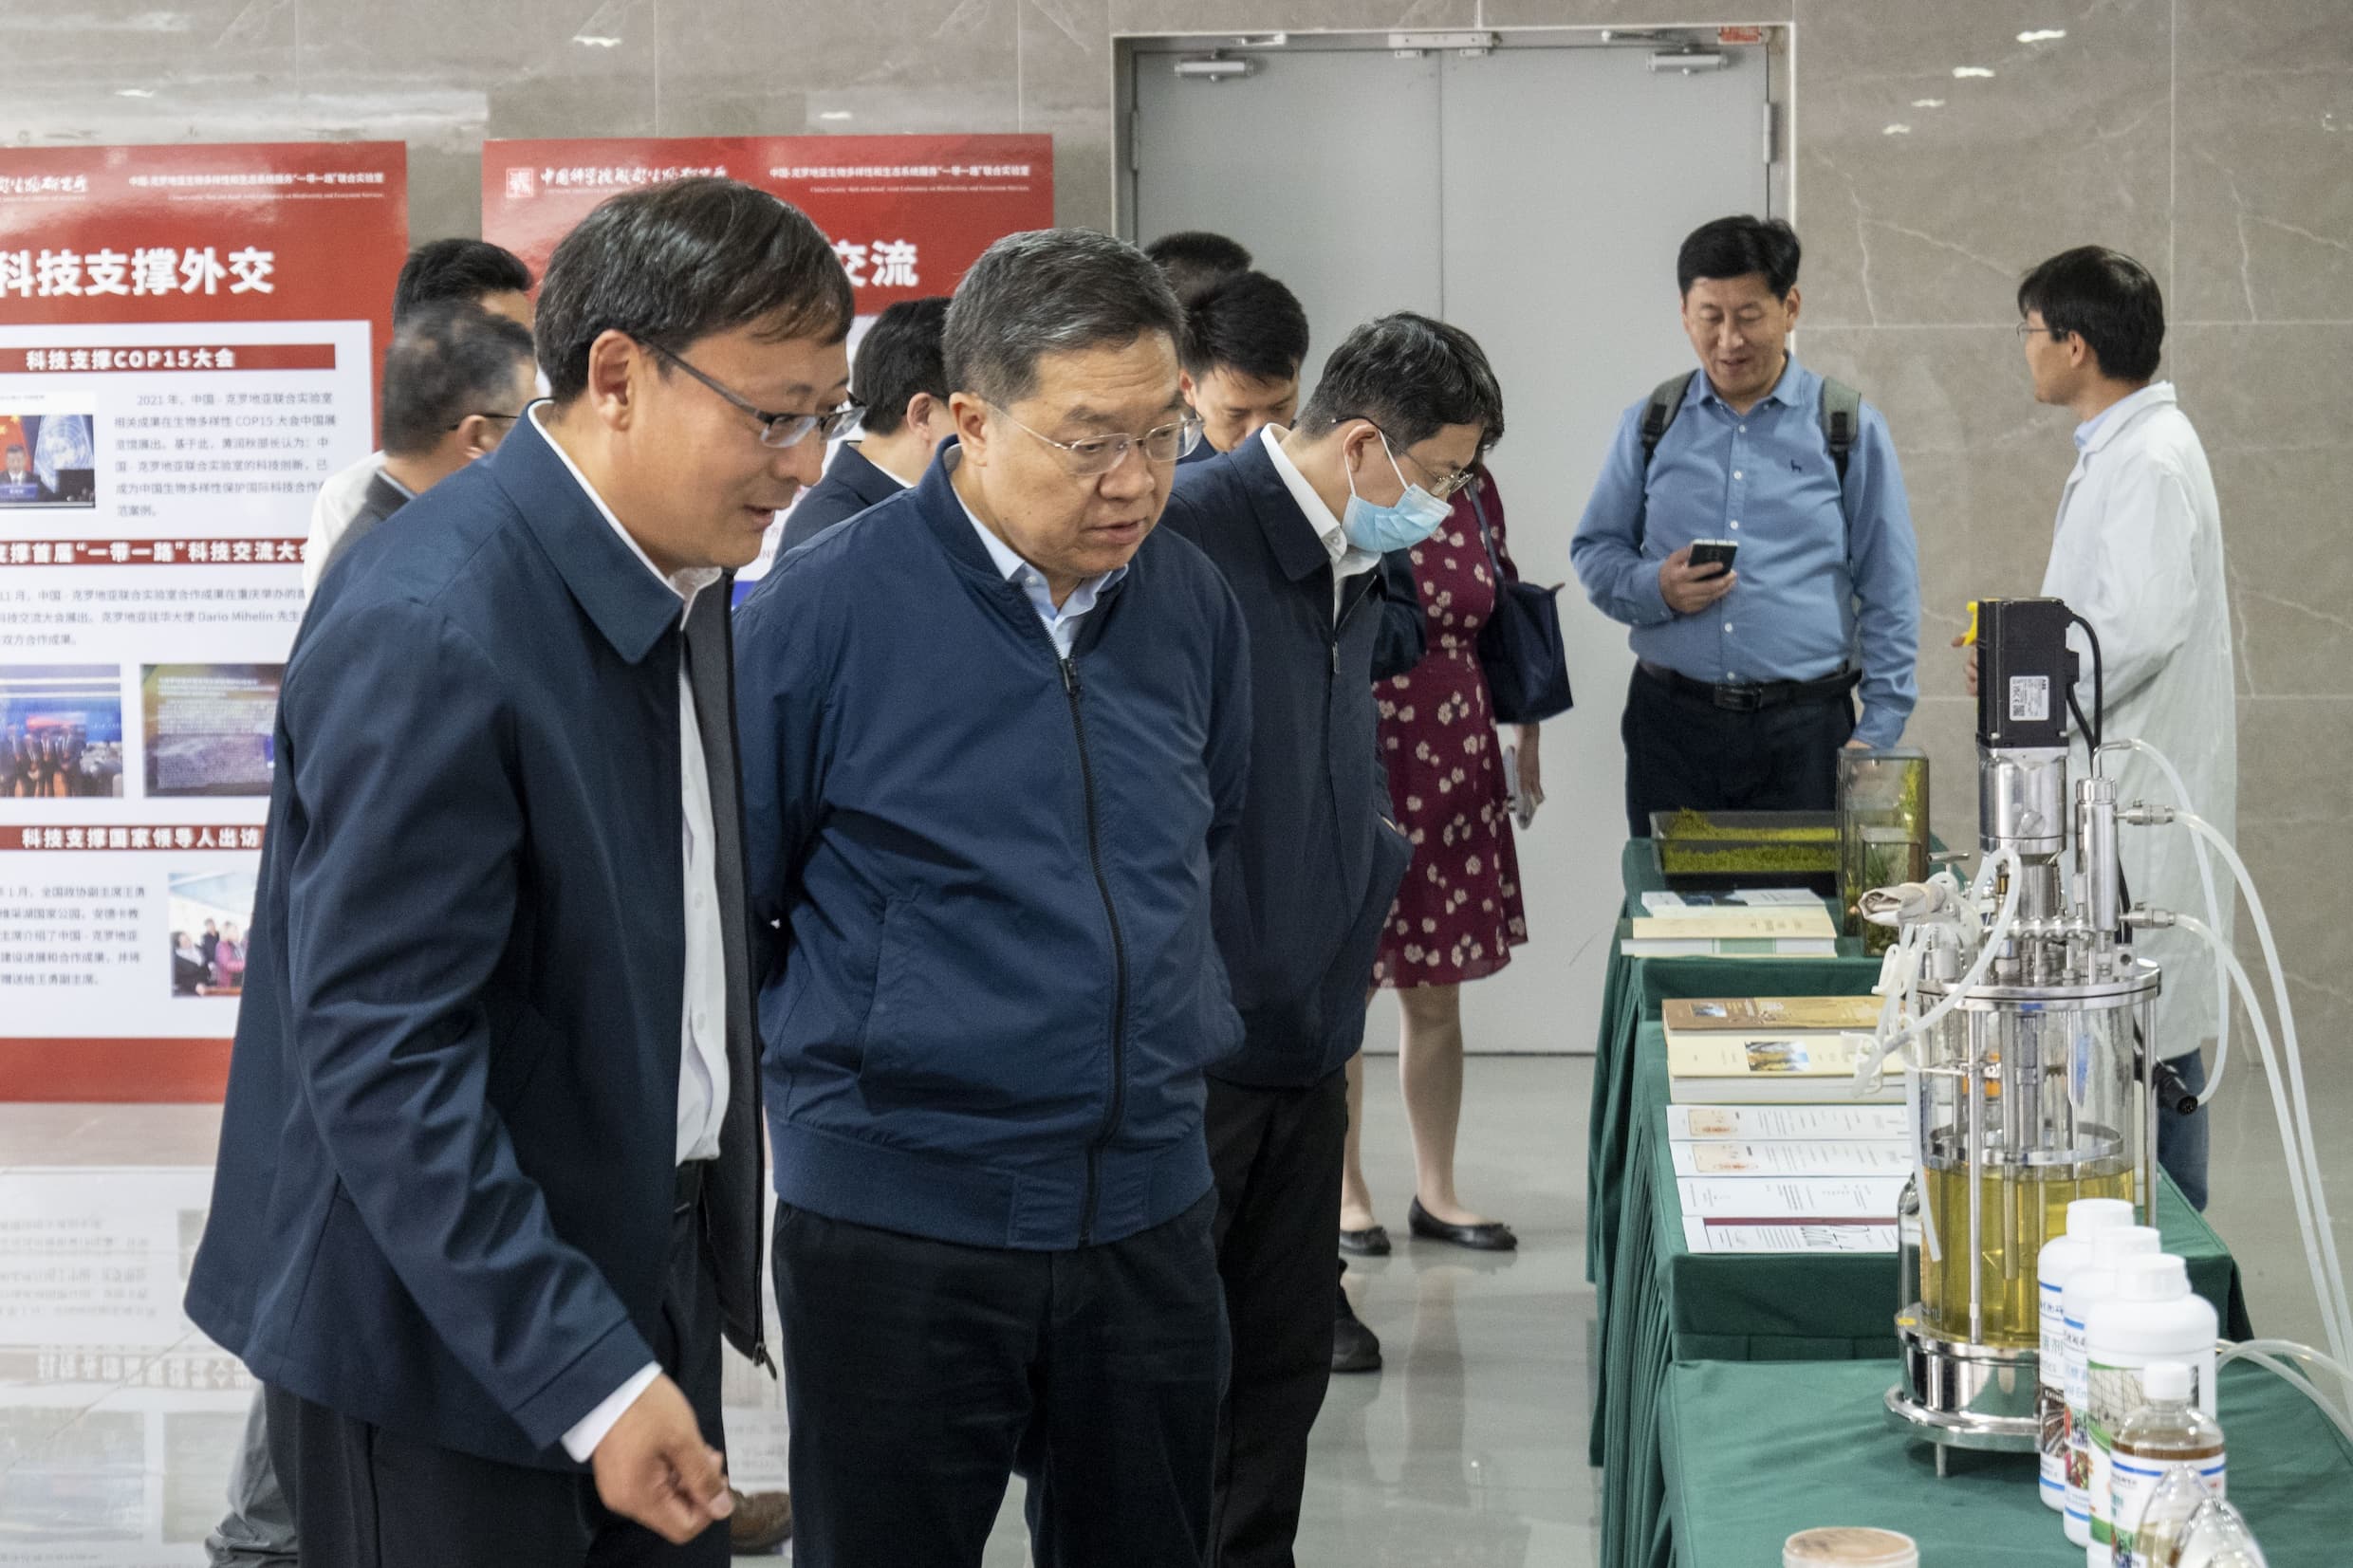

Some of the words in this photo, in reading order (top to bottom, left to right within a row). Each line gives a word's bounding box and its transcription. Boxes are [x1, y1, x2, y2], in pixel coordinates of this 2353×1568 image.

[0, 246, 274, 297] 科技支撑外交
[26, 347, 236, 370] 科技支撑COP15大会
[22, 827, 260, 849] 科技支撑国家领导人出访
